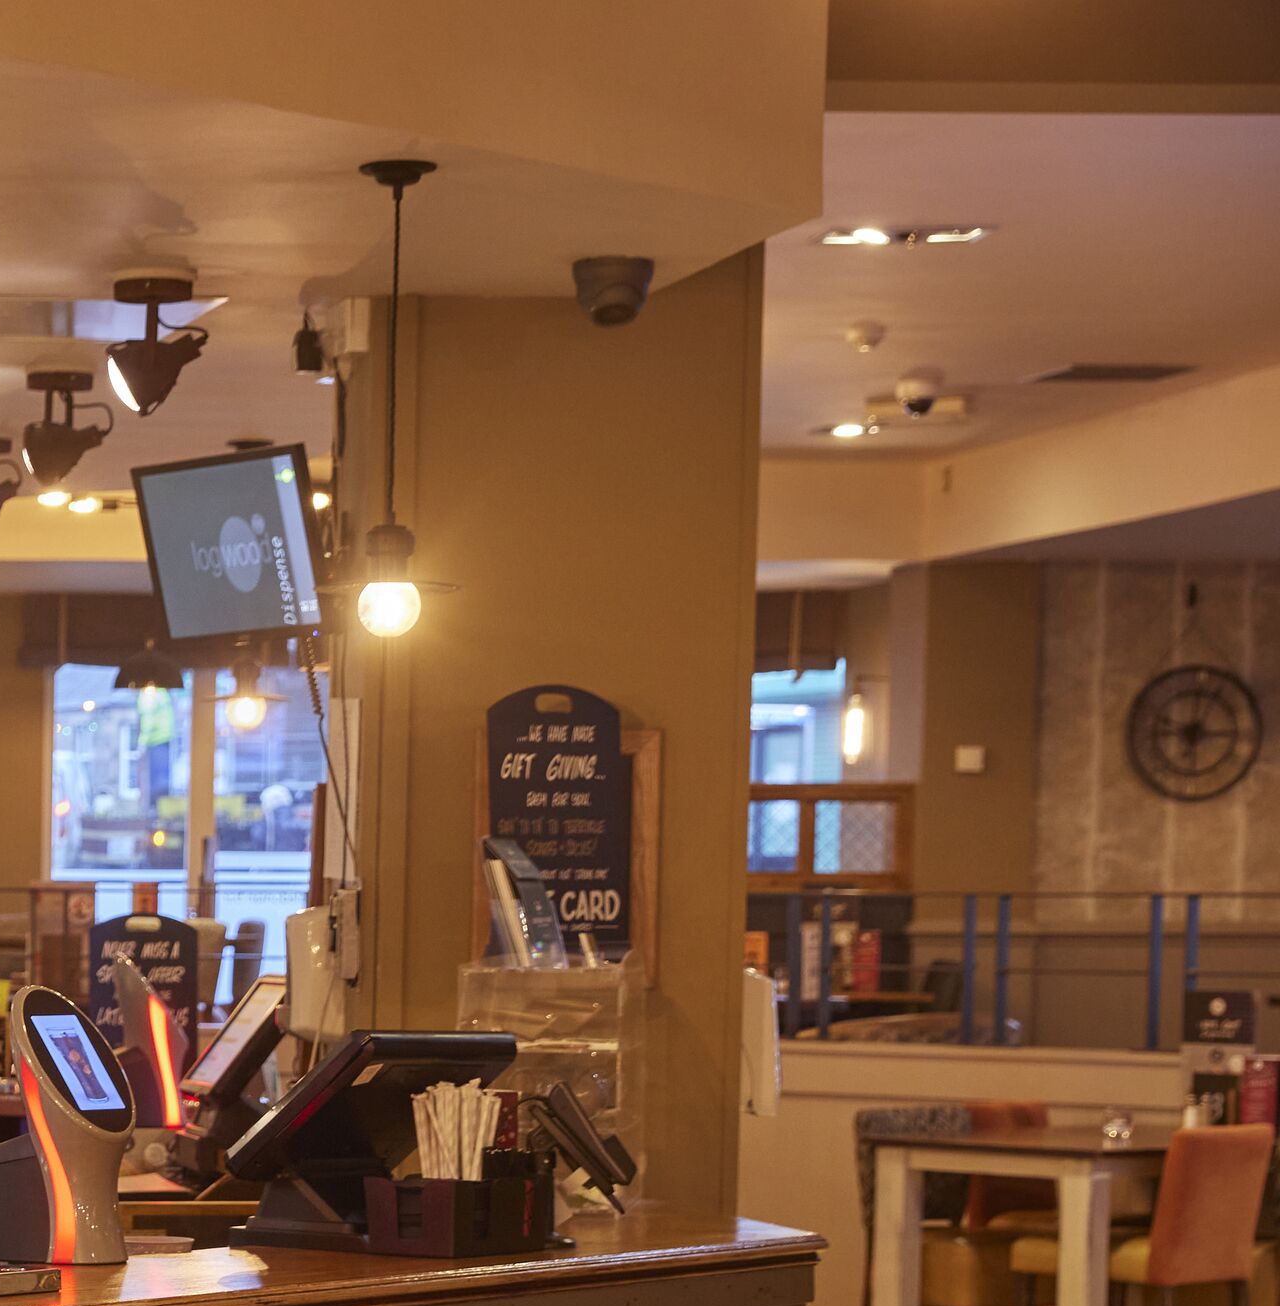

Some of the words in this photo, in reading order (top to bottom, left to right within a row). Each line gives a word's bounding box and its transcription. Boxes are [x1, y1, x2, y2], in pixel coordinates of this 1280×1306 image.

[271, 536, 298, 626] Dispense
[500, 752, 537, 780] GIFT
[559, 888, 621, 922] CARD
